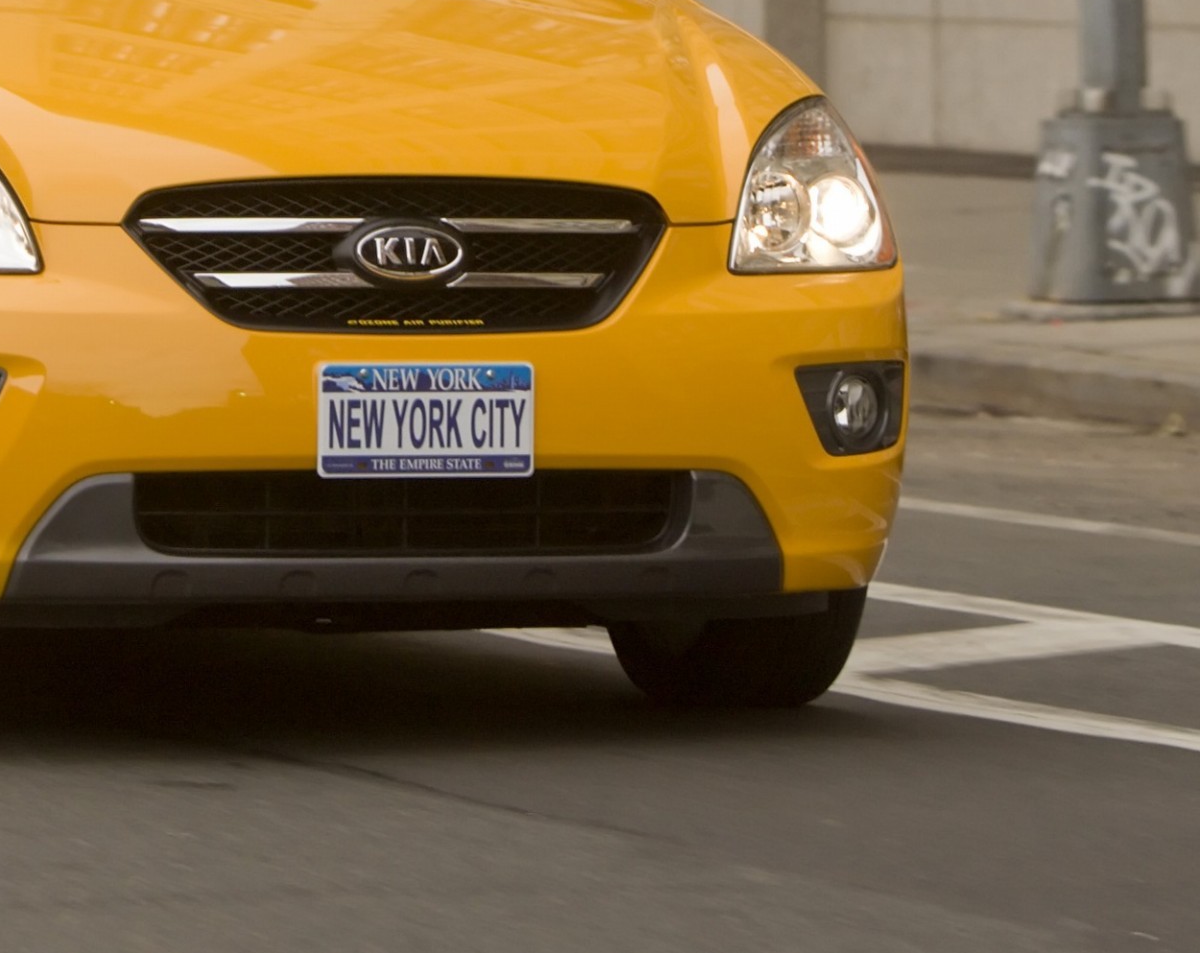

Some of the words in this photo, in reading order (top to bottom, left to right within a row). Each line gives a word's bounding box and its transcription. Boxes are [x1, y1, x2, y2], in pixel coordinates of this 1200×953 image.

[373, 236, 447, 266] KIA
[370, 368, 421, 391] NEW
[424, 368, 483, 391] YORK
[329, 398, 386, 450] NEW
[392, 398, 463, 450] YORK
[470, 398, 526, 449] CITY
[371, 458, 397, 471] THE
[400, 458, 445, 471] EMPIRE
[446, 458, 483, 470] STATE
